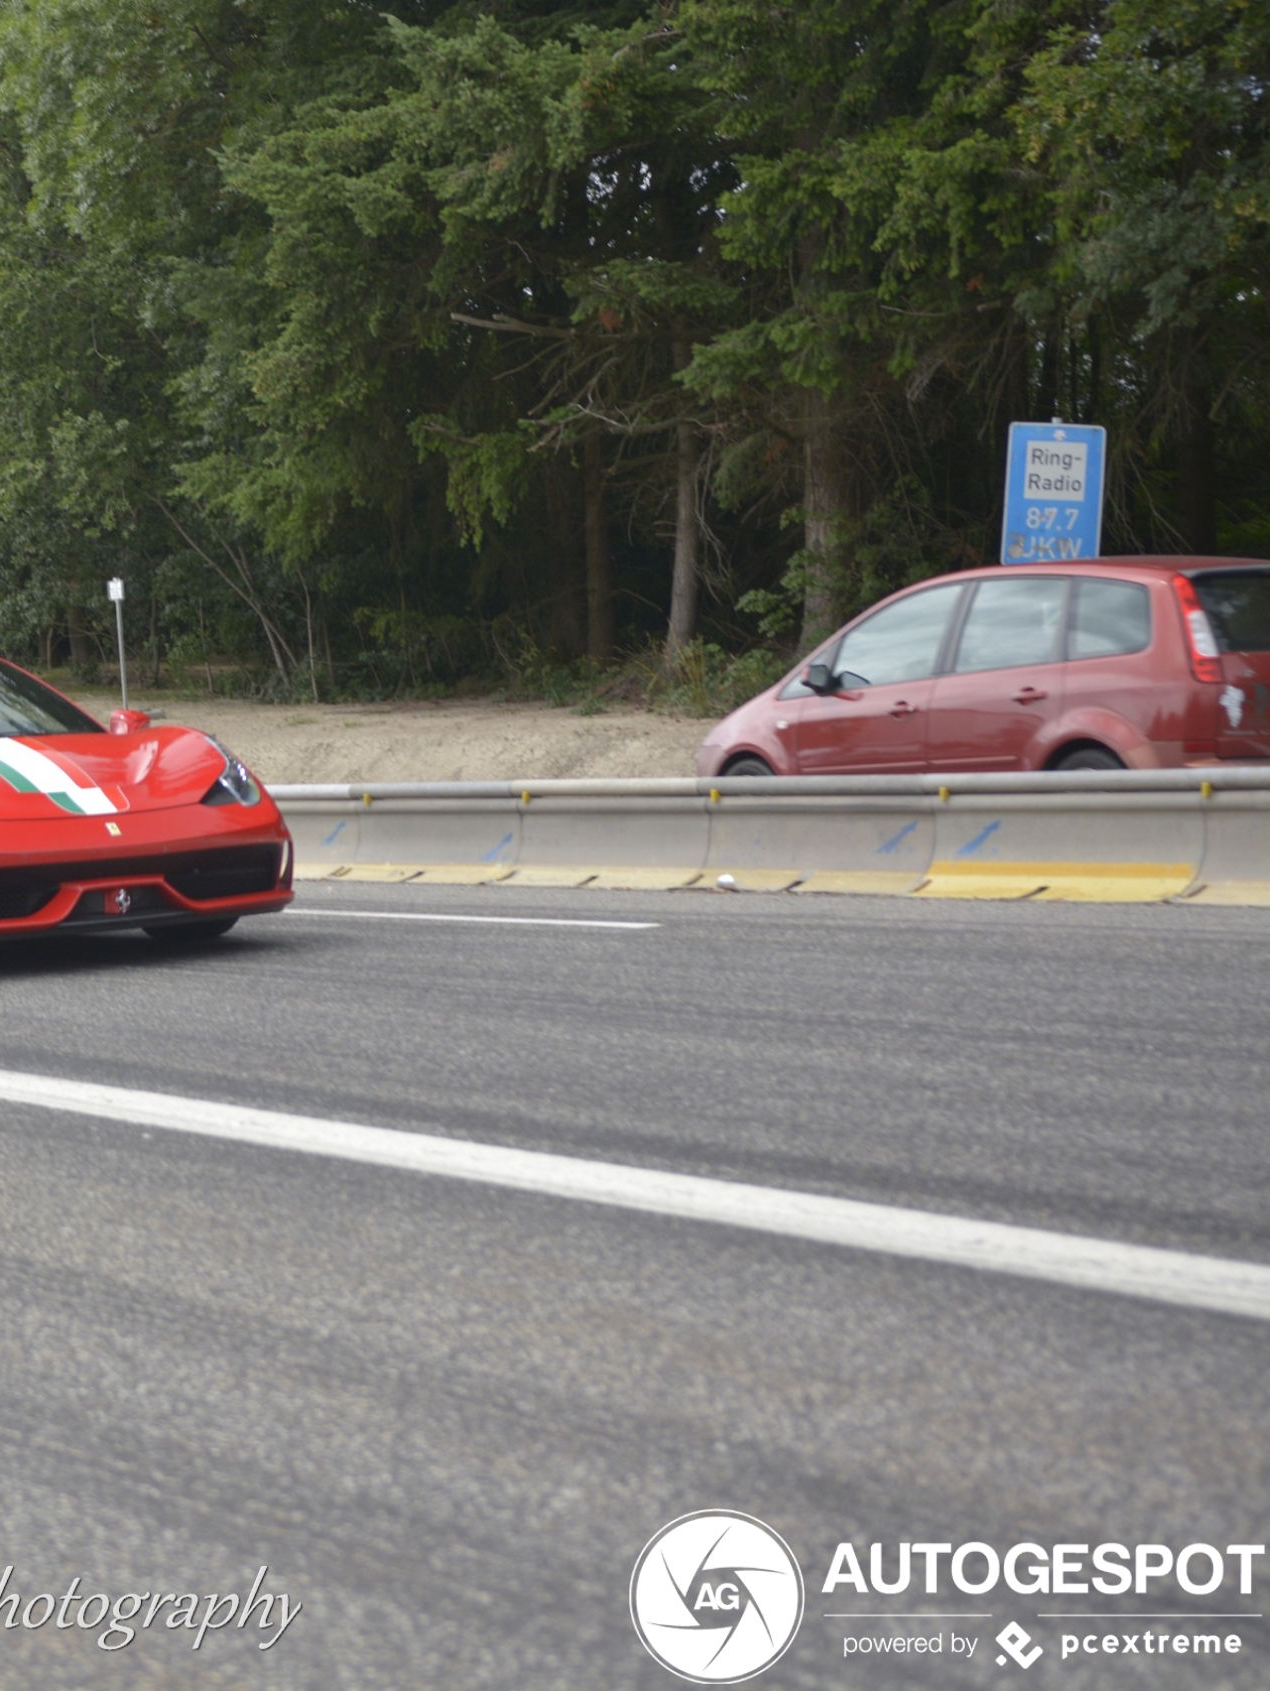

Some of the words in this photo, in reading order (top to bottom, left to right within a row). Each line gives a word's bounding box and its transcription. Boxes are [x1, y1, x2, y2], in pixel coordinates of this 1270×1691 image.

[1031, 448, 1082, 470] Ring-
[1028, 473, 1082, 492] Radio
[1025, 506, 1079, 531] 87.7
